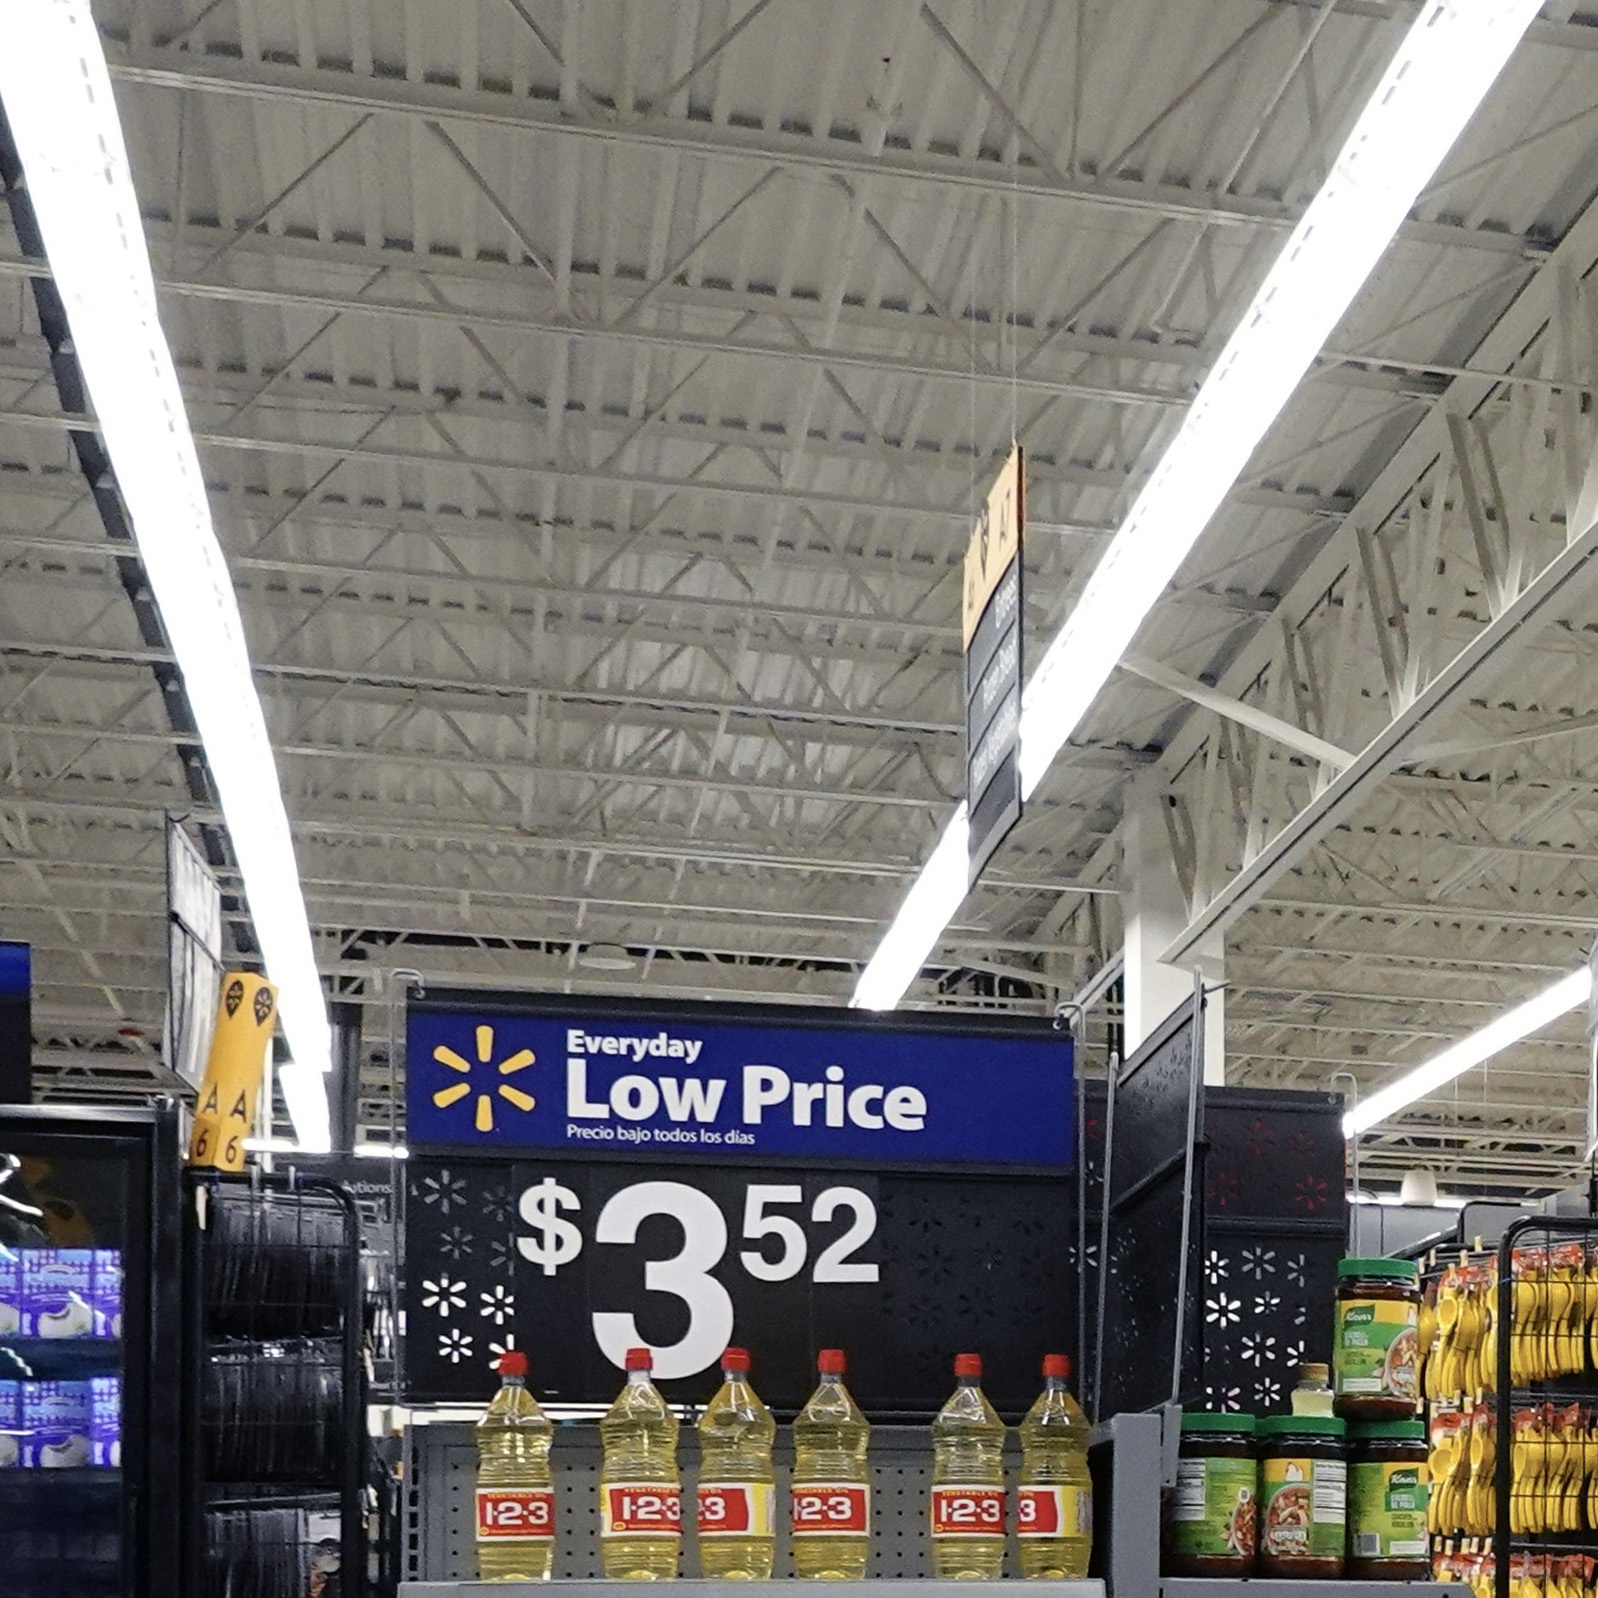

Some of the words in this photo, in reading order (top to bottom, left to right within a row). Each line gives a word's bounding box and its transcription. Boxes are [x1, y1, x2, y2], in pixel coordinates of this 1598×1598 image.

[567, 1029, 703, 1065] Everyday
[203, 1085, 218, 1114] A
[230, 1089, 247, 1123] A
[566, 1057, 726, 1124] Low
[742, 1065, 928, 1133] Price
[196, 1129, 208, 1157] 6
[566, 1124, 614, 1142] Precio
[617, 1125, 650, 1146] bajo
[653, 1126, 698, 1144] todos
[700, 1127, 721, 1145] los
[224, 1136, 238, 1164] 6
